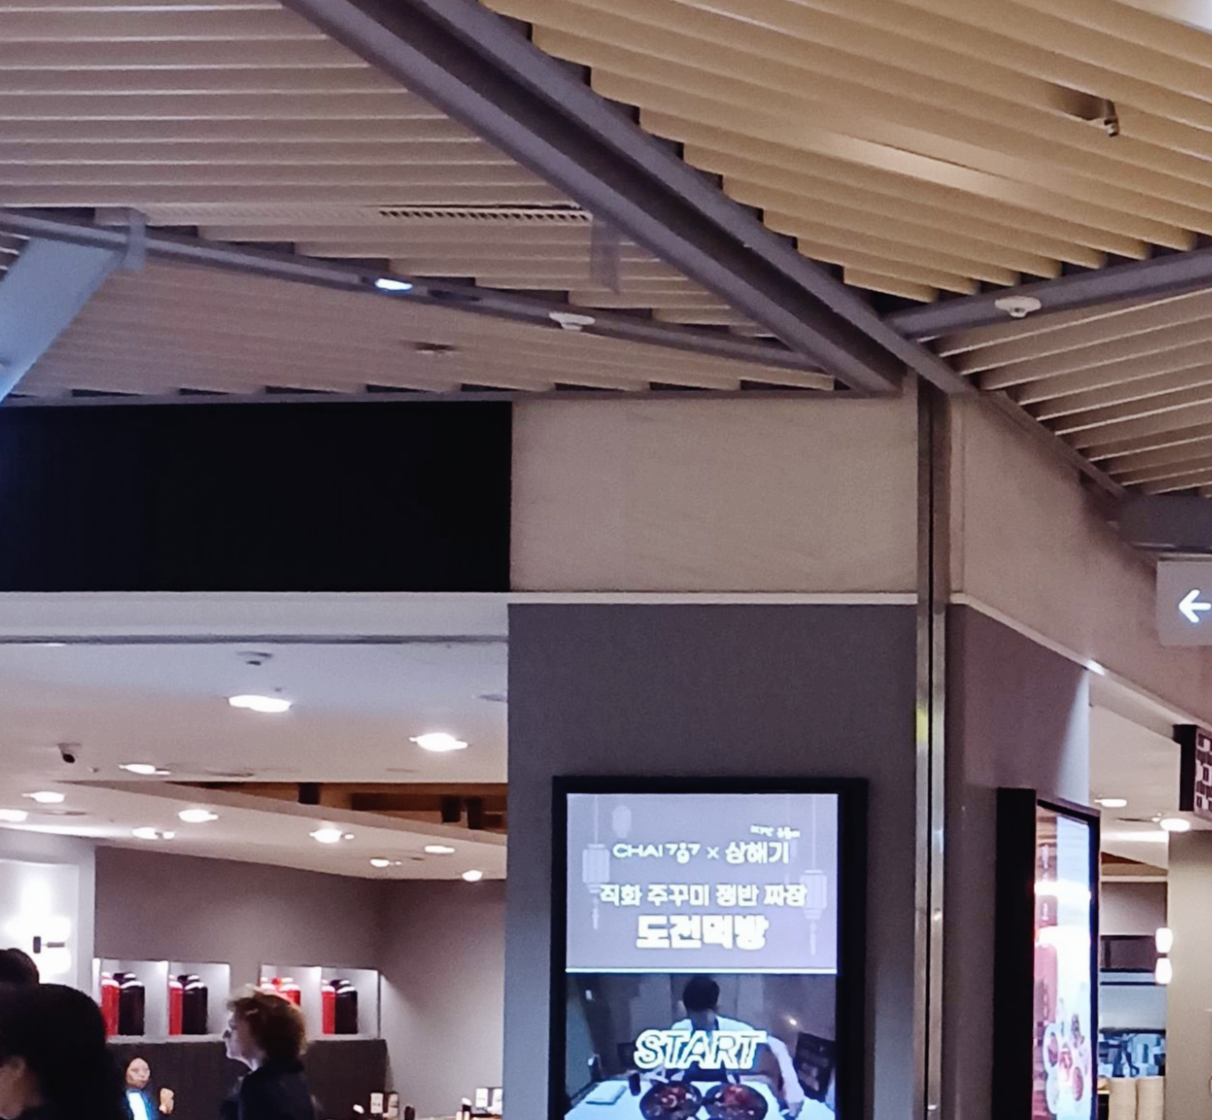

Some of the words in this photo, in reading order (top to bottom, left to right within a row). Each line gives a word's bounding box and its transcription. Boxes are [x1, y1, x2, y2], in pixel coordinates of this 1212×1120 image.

[725, 841, 789, 864] 상해기
[600, 884, 642, 907] 직화
[647, 884, 709, 907] 주꾸미
[716, 884, 759, 907] 쟁반
[763, 884, 808, 907] 짜장
[636, 914, 769, 950] 도전먹방
[634, 1030, 767, 1070] START
